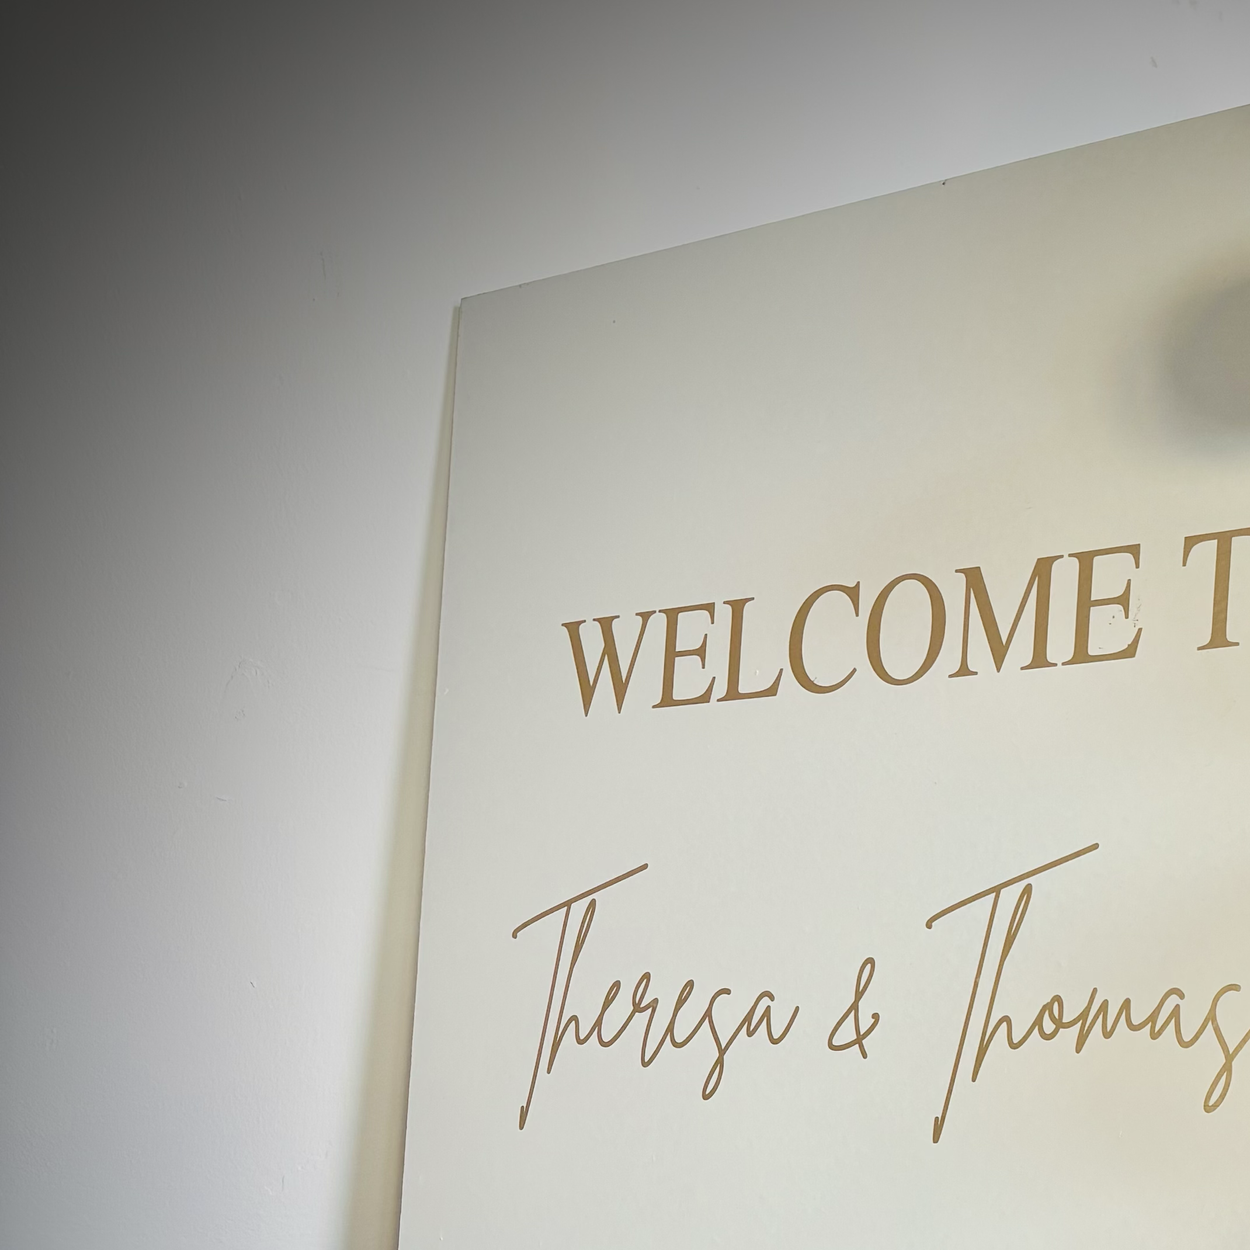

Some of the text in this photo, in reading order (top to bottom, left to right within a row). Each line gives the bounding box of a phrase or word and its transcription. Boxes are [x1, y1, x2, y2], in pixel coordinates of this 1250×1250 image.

[561, 543, 1143, 717] WELCOME
[511, 862, 800, 1130] Theresa
[827, 956, 881, 1060] &
